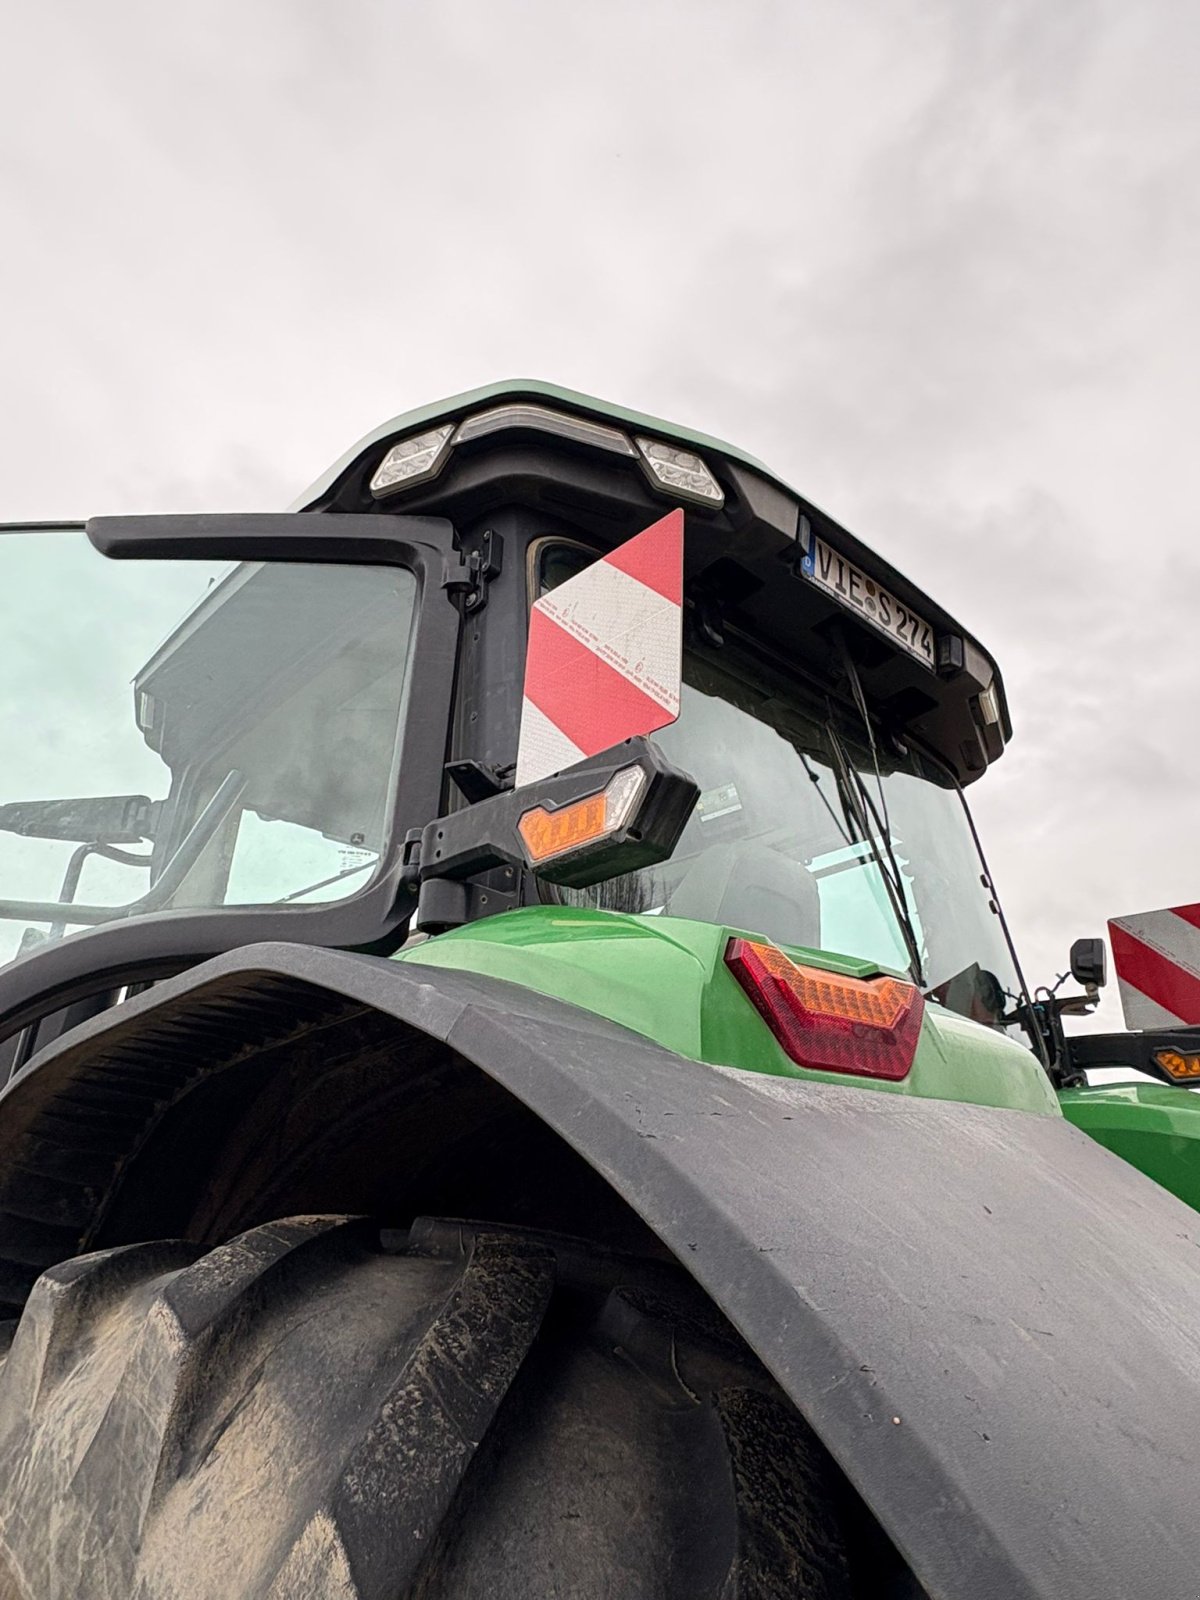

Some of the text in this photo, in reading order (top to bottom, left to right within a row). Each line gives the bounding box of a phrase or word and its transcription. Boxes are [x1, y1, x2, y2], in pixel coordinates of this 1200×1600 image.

[804, 557, 811, 567] D
[818, 544, 864, 607] VIE
[878, 592, 892, 627] S
[896, 608, 932, 658] 274
